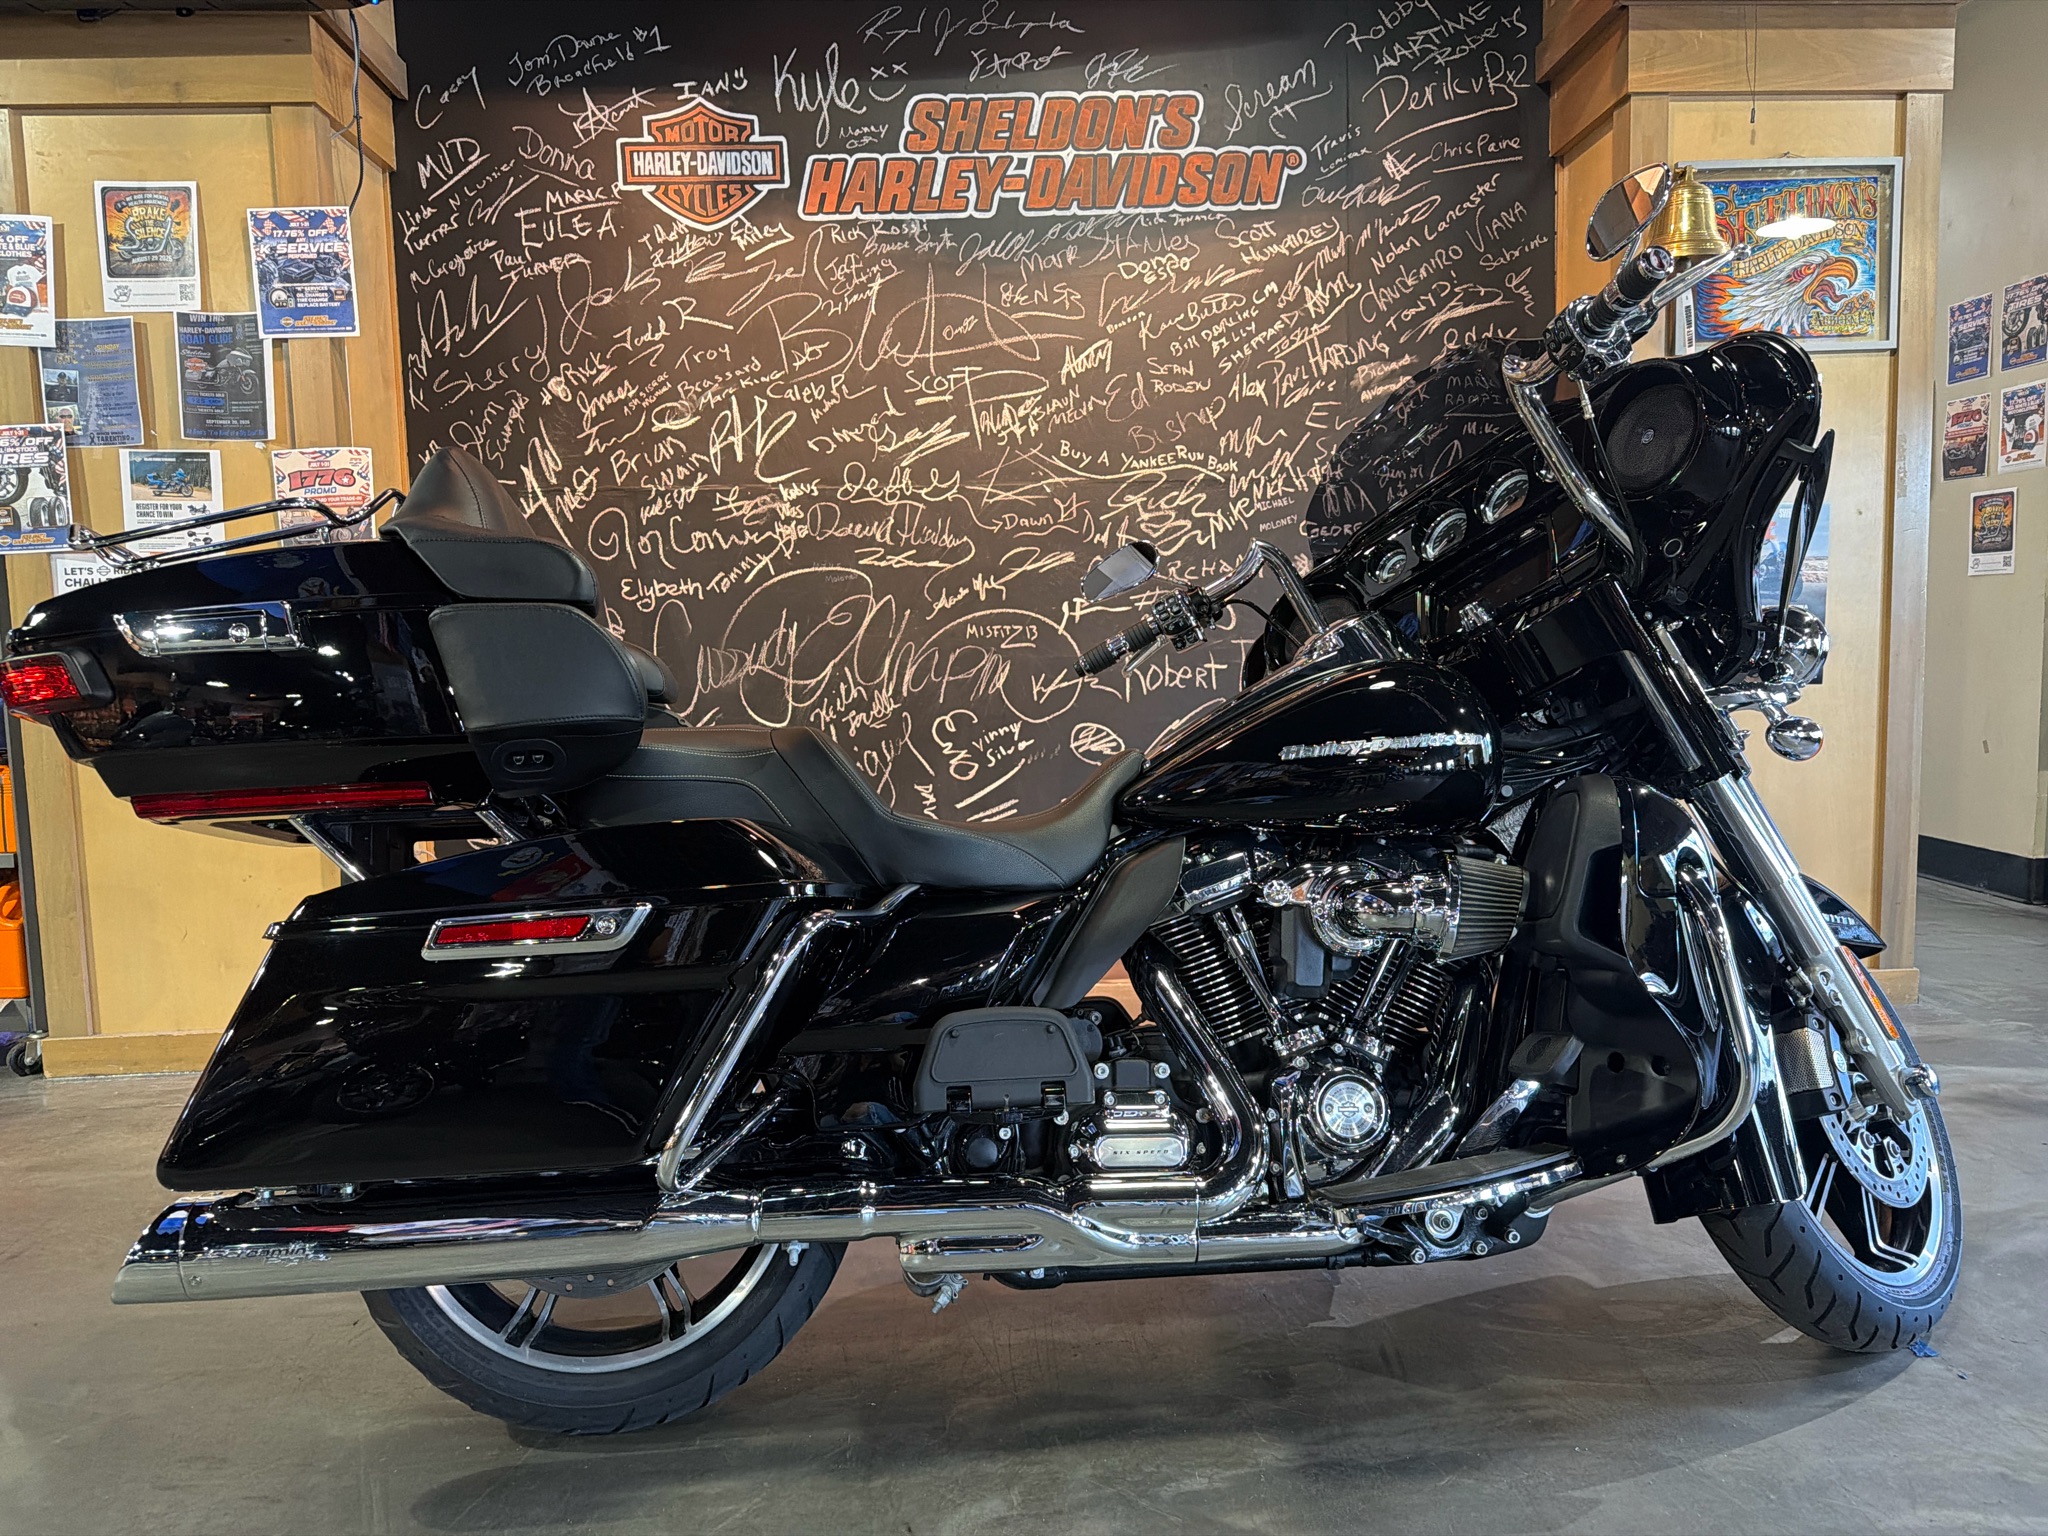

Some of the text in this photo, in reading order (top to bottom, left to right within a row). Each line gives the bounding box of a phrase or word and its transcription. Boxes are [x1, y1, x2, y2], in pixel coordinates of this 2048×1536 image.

[773, 42, 867, 148] Kyle
[665, 114, 739, 142] MOTOR
[906, 96, 1197, 151] SHELDON'S
[512, 126, 597, 181] Donna
[633, 151, 773, 176] HARLEY-DAVIDSON
[668, 184, 742, 216] CYCLES
[132, 206, 167, 221] BRAKE
[1371, 235, 1420, 275] Nolan
[1424, 173, 1500, 240] Lancaster
[6, 235, 29, 243] OFF
[135, 226, 166, 240] SILENCE
[273, 228, 328, 238] 17.76% OFF
[15, 243, 36, 251] BLUE
[260, 242, 344, 254] K SERVICE
[2009, 293, 2043, 309] TIRES
[189, 314, 225, 323] WIN THIS
[179, 326, 233, 335] HARLEY-DAVIDSON
[179, 333, 233, 345] ROAD GLIDE
[767, 381, 827, 404] Caleb
[25, 436, 54, 446] OFF
[611, 436, 687, 486] Brian
[1097, 451, 1109, 466] A
[1121, 452, 1177, 472] YANKEE
[289, 468, 356, 492] 1776
[304, 486, 337, 495] PROMO
[136, 503, 183, 511] REGISTER FOR YOUR
[1254, 497, 1295, 512] MICHAEL
[1002, 513, 1054, 530] Dawn
[1260, 514, 1298, 532] MOLONEY
[64, 567, 94, 576] LET'S
[1025, 625, 1039, 641] 13
